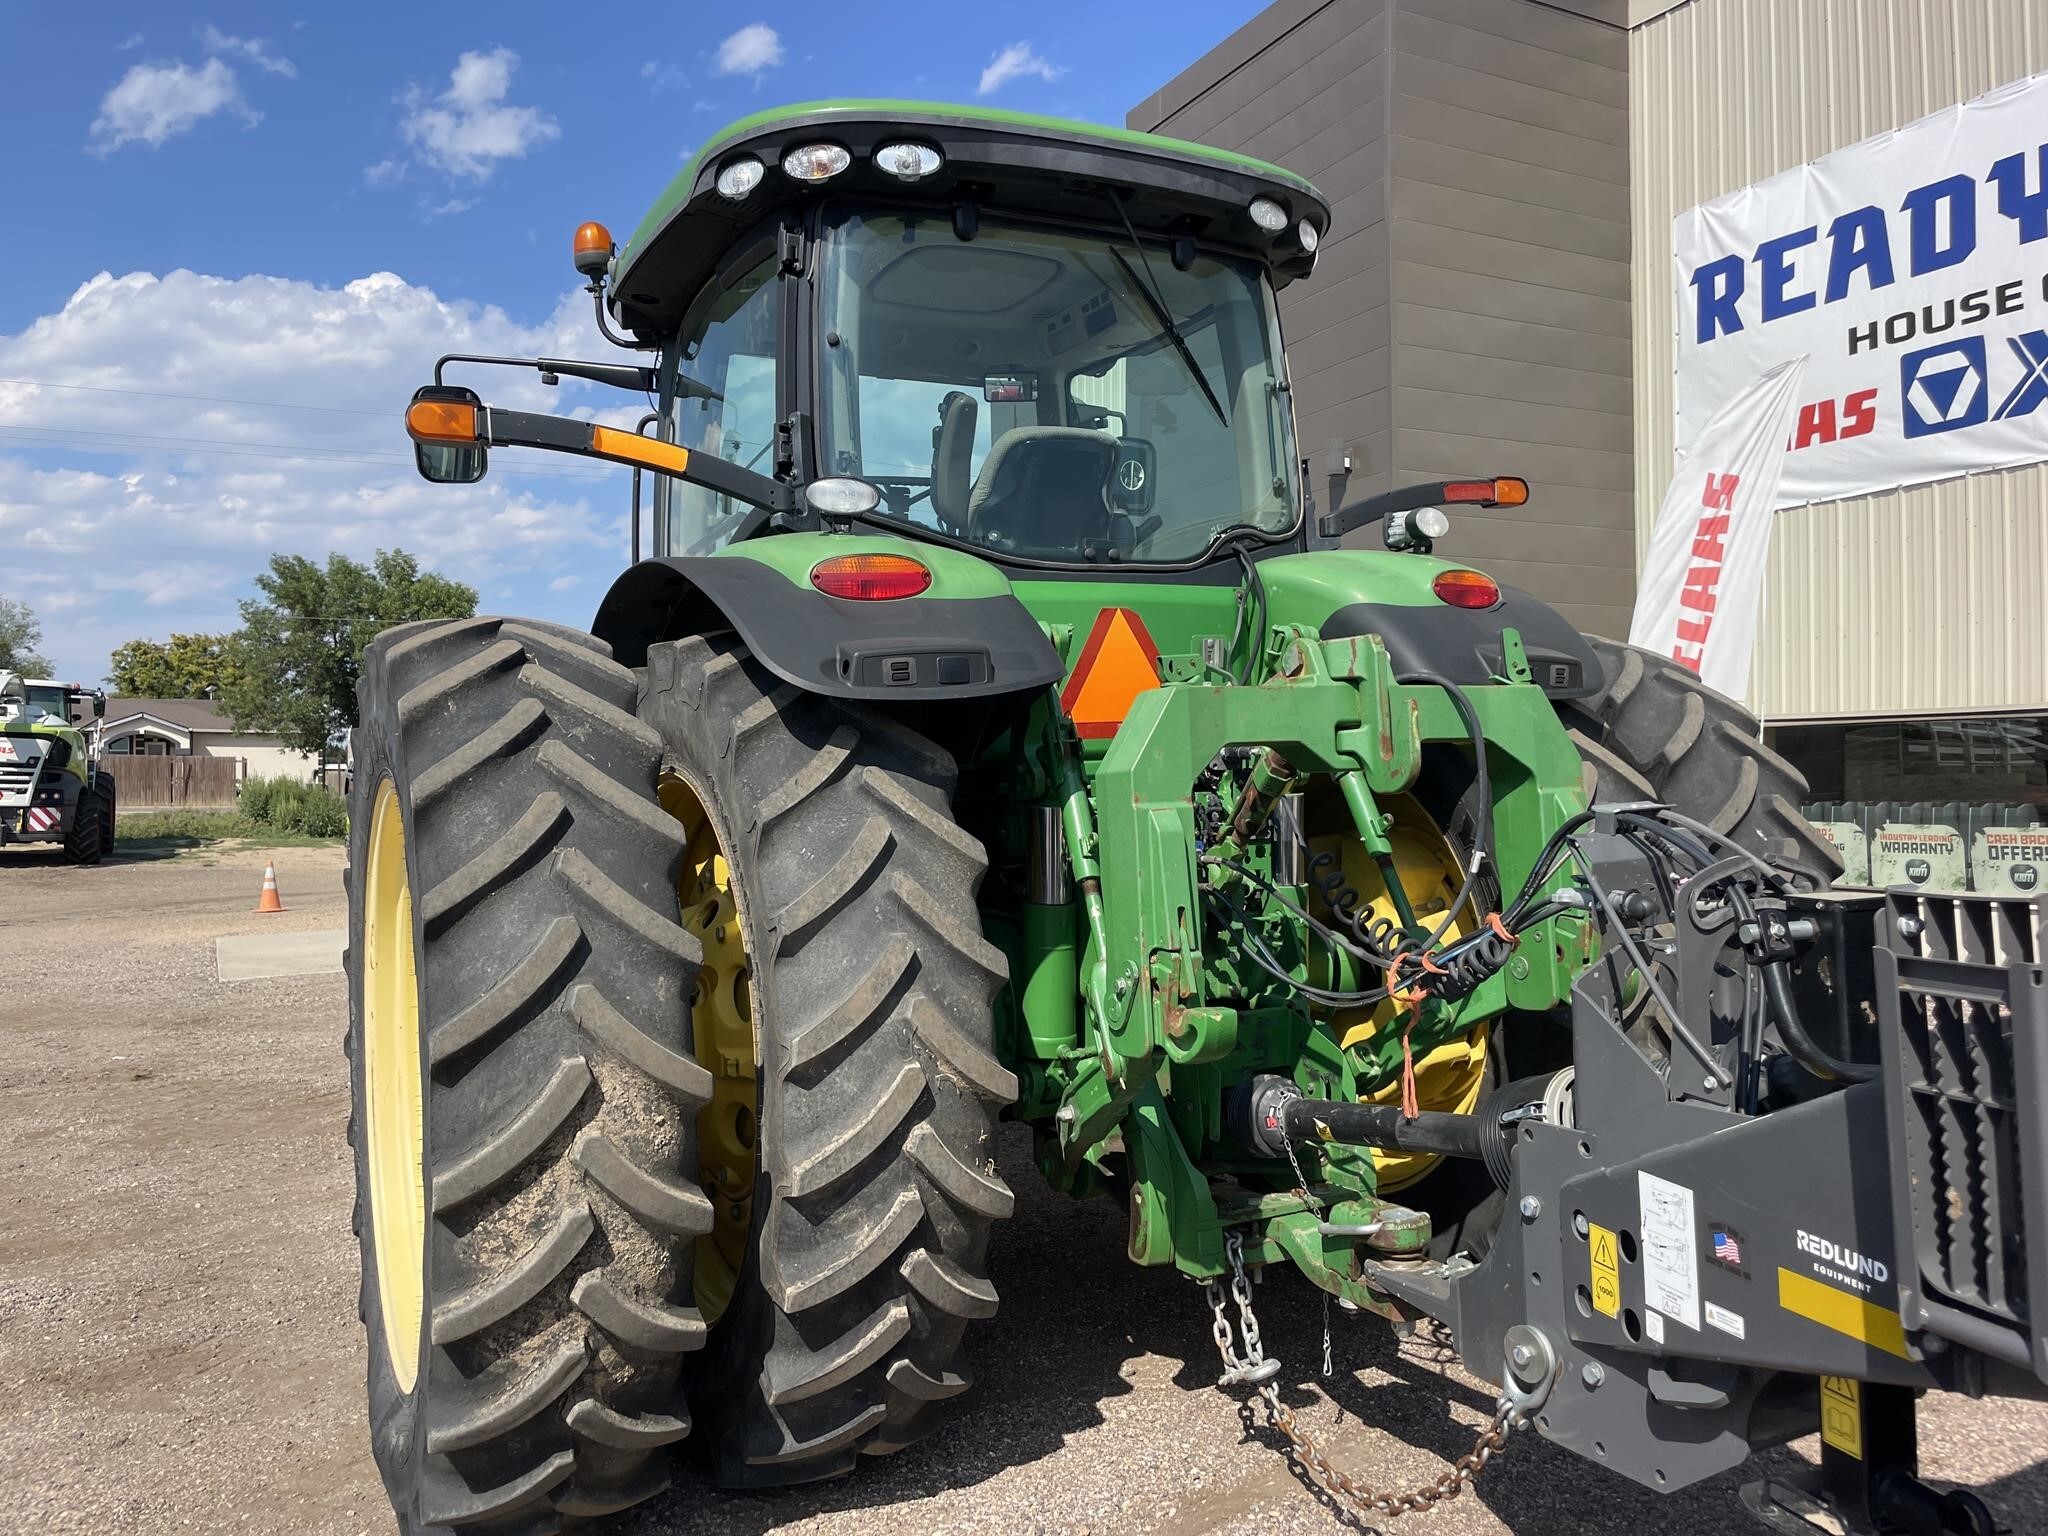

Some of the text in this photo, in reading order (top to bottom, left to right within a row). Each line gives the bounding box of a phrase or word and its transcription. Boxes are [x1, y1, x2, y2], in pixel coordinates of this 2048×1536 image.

[1689, 143, 2048, 345] READY
[1848, 280, 2024, 356] HOUSE
[1880, 833, 1953, 843] INDUSTRY LEADING
[1881, 842, 1954, 855] WARRANTY
[1986, 834, 2017, 844] CASH
[1796, 1229, 1888, 1282] REDLUND
[1813, 1262, 1871, 1294] EQUIPMENT
